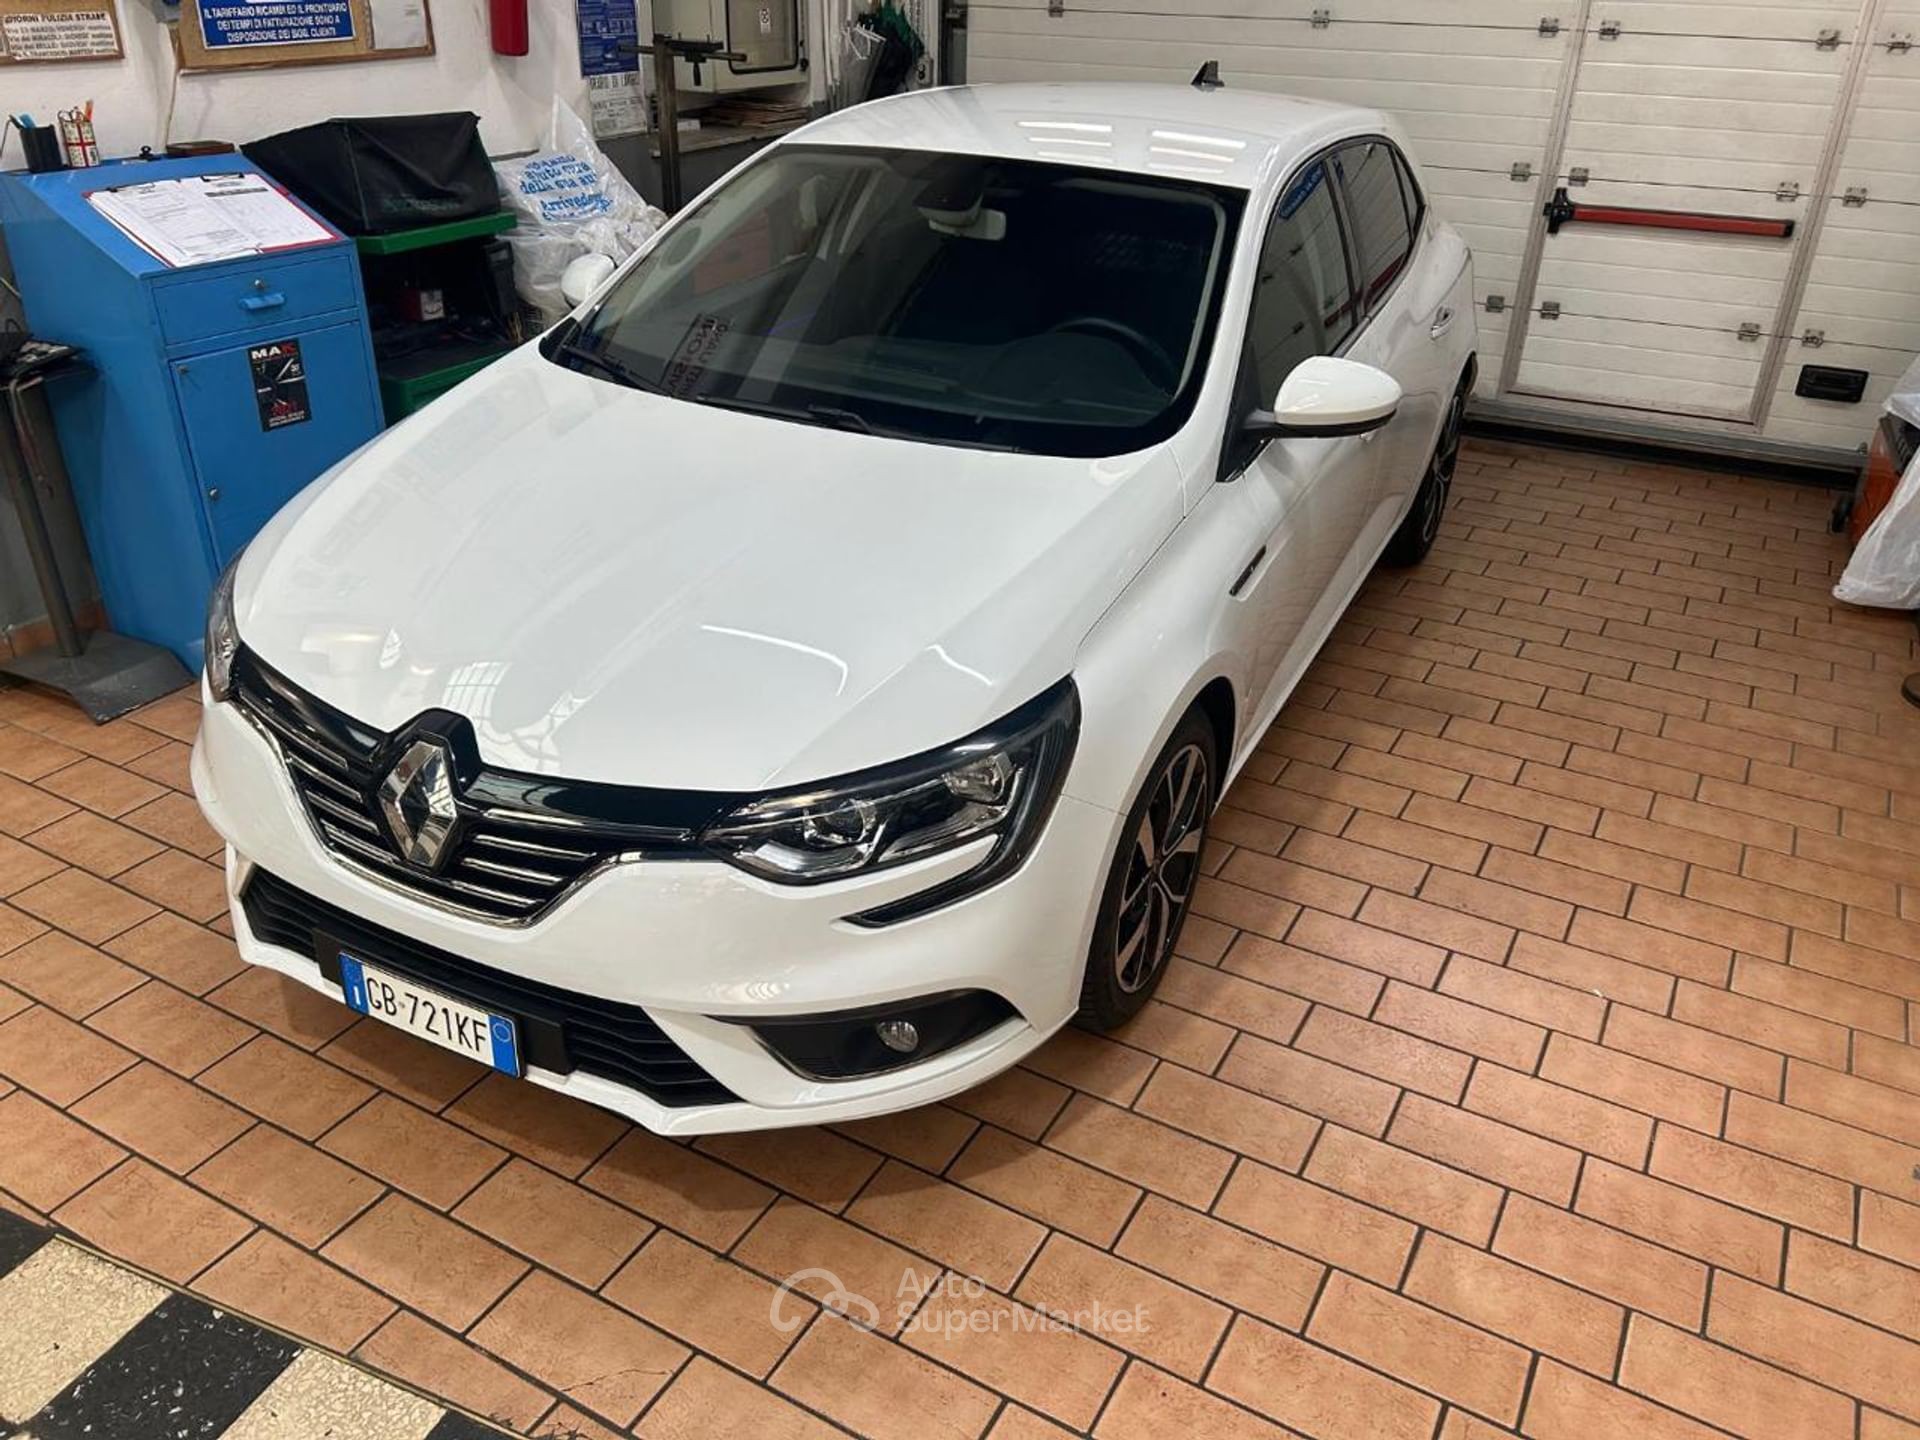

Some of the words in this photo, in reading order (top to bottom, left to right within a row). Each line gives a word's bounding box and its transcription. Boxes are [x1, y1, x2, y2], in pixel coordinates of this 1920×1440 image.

[212, 6, 254, 18] TARIFFARIO
[305, 2, 348, 13] PRONTUARIO
[41, 14, 74, 22] PULIZIA
[75, 13, 106, 21] STRADE
[230, 18, 253, 30] TEMPI
[262, 16, 314, 28] FATTURAZIONE
[227, 29, 278, 42] DISPOSIZIONE
[404, 992, 488, 1052] 721KF
